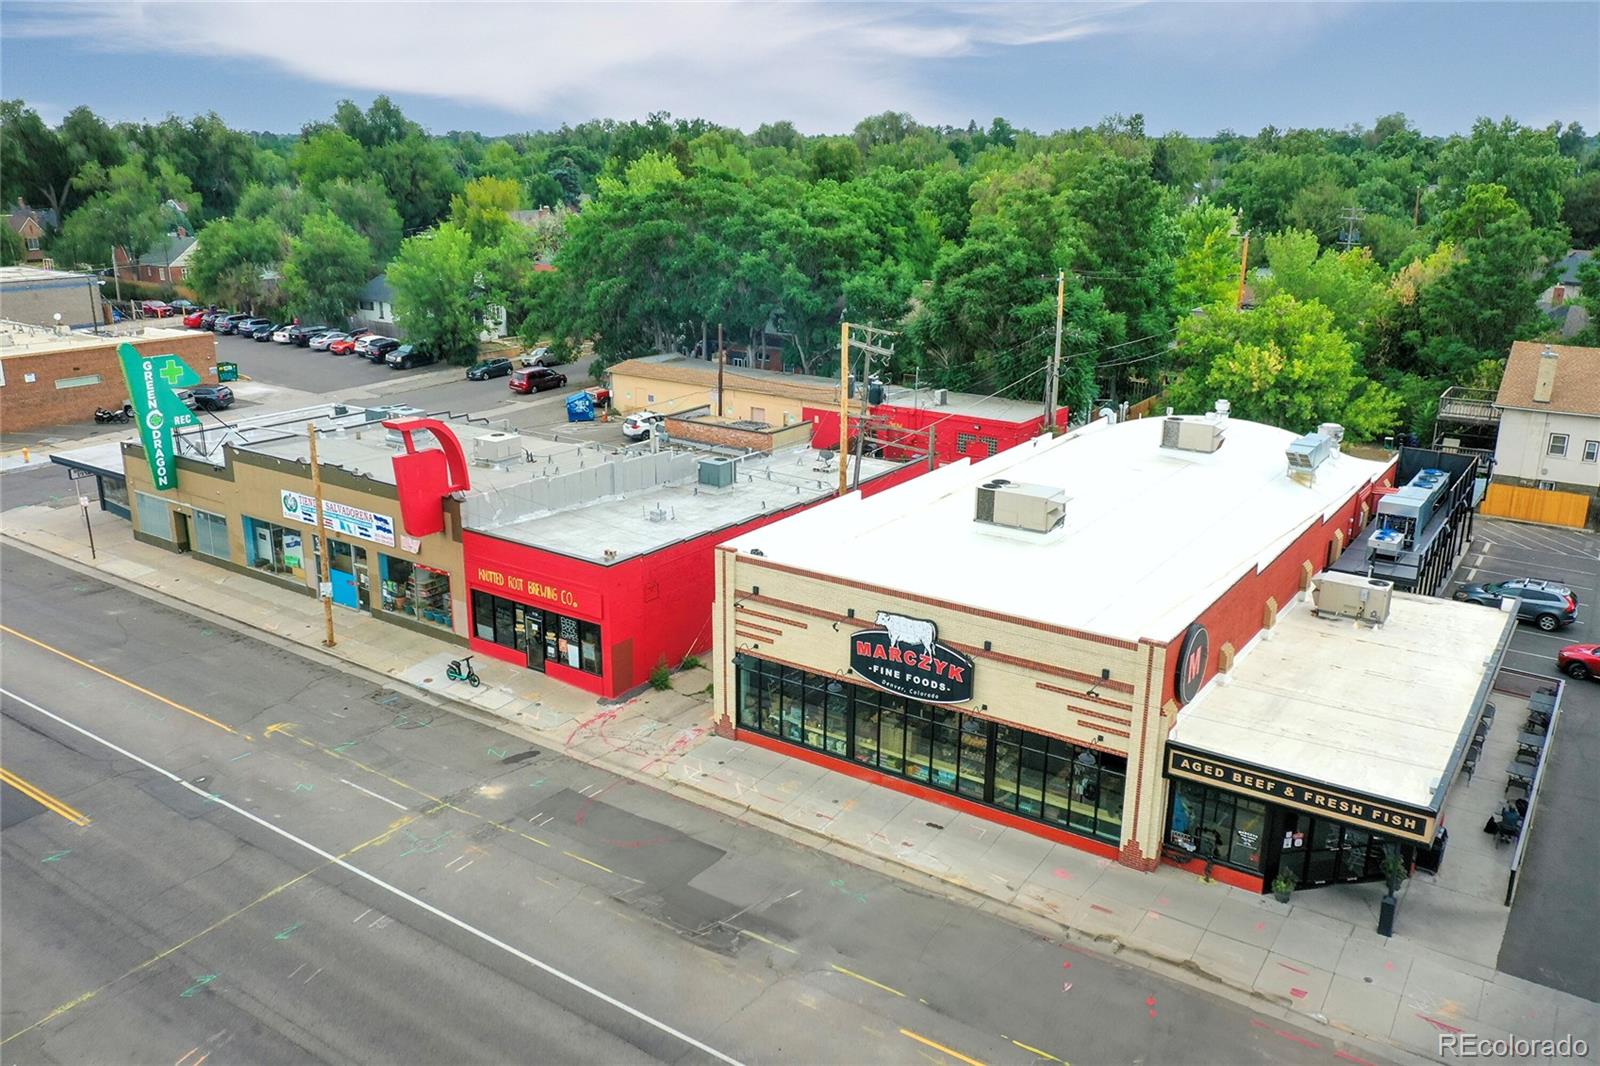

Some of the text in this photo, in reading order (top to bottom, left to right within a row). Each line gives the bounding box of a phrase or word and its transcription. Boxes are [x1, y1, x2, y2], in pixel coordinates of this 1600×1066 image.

[142, 360, 158, 409] GREEN
[174, 414, 192, 425] REC
[151, 430, 168, 486] DRAGON
[478, 568, 578, 608] KNOTTED ROOT BREWING CO.
[856, 640, 965, 683] MARCZYK
[1187, 645, 1202, 684] M
[881, 679, 939, 699] Denver, Colorado
[1180, 758, 1417, 830] AGED BEEF & FRESH FISH
